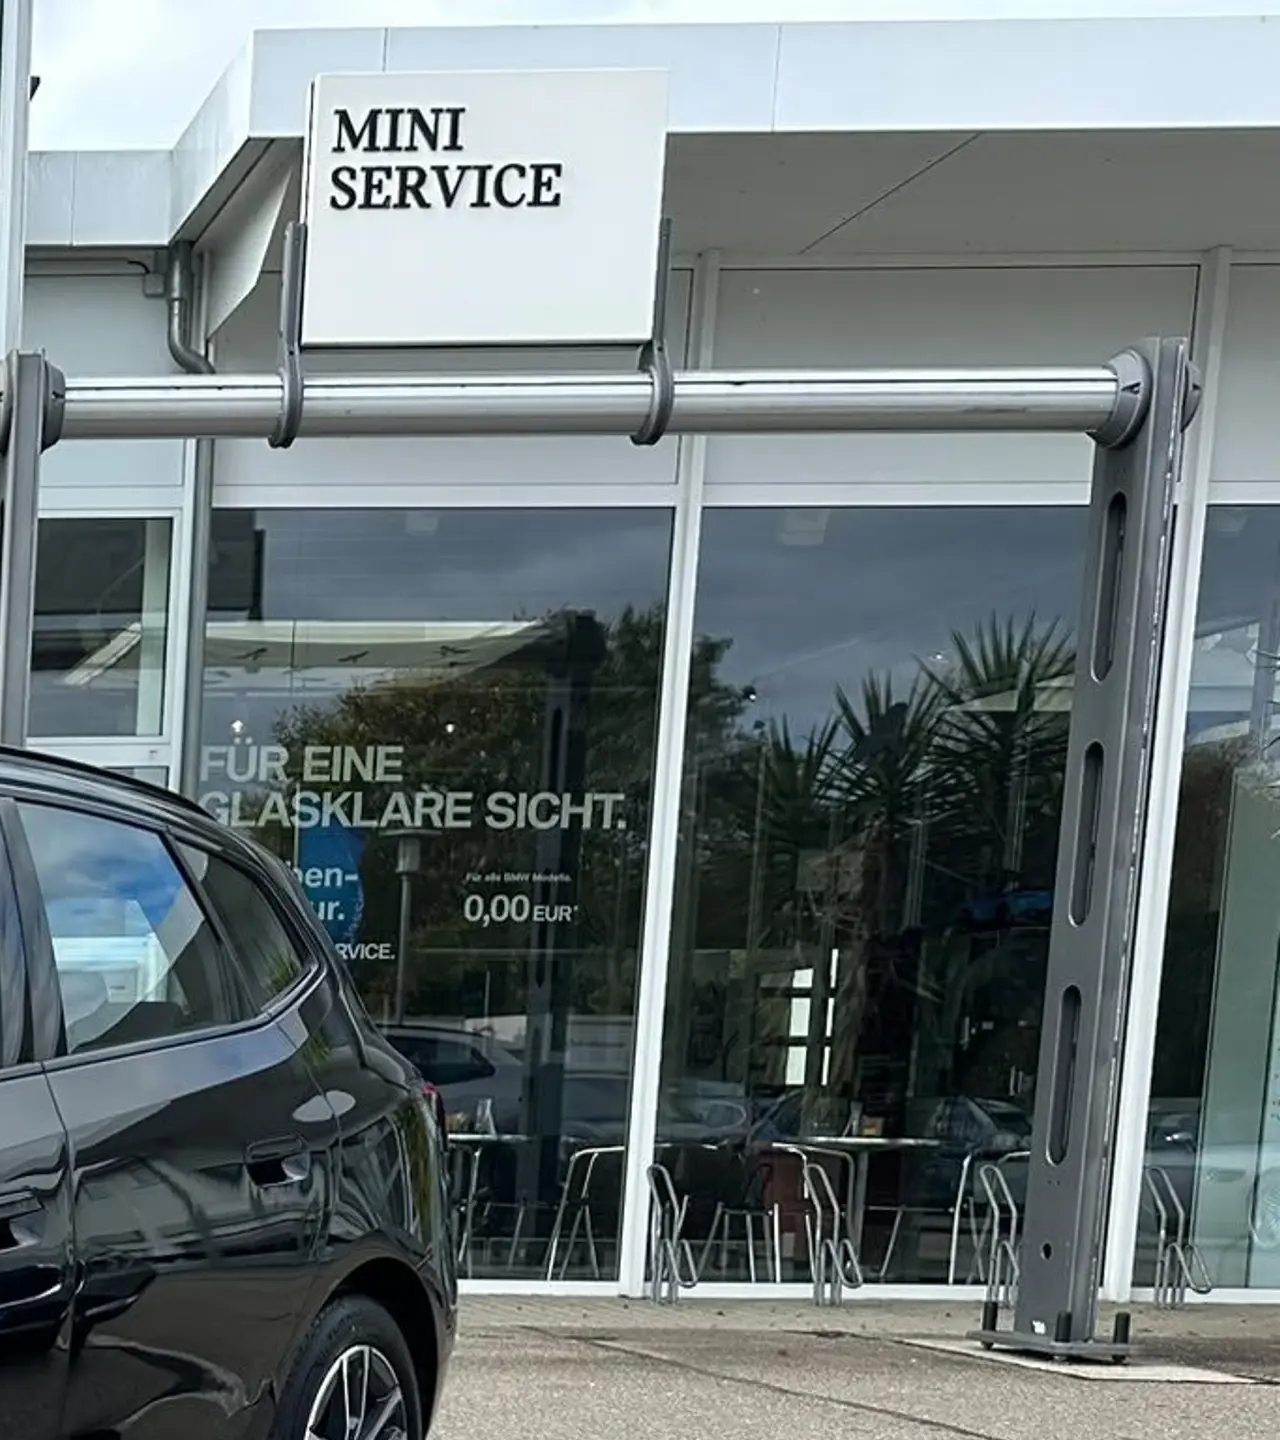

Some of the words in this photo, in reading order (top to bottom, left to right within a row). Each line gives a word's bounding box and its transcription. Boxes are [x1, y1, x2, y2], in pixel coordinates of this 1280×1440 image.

[331, 107, 466, 152] MINI
[329, 162, 564, 211] SERVICE
[200, 737, 290, 783] FÜR
[302, 744, 404, 782] EINE
[199, 790, 474, 830] GLASKLARE
[484, 791, 627, 831] SICHT.
[503, 871, 531, 883] BMW
[464, 894, 531, 927] 0,00
